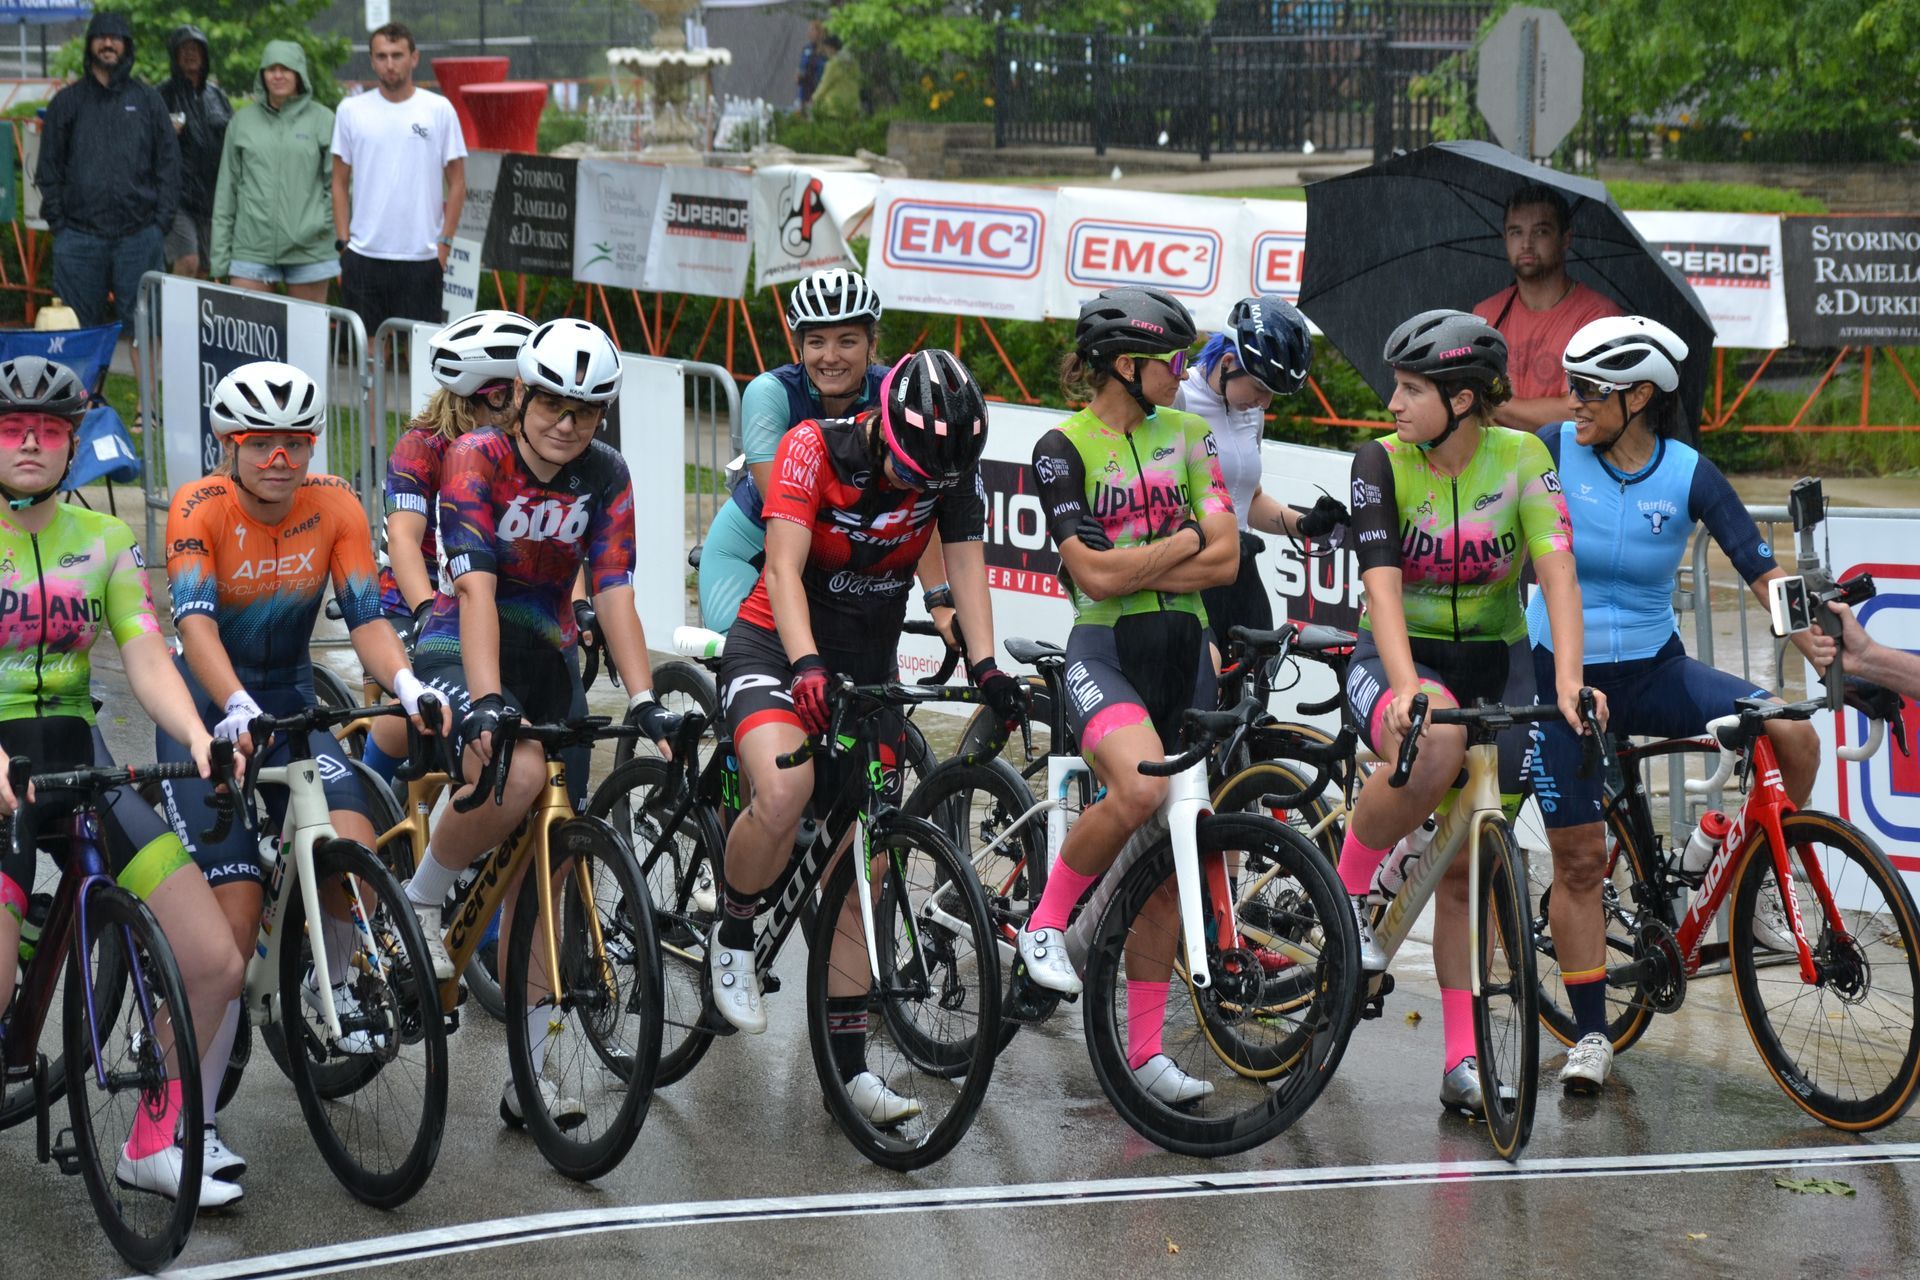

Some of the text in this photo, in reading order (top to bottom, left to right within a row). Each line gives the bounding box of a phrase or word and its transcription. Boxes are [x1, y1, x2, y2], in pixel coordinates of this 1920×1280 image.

[512, 162, 566, 193] STORINO,
[512, 192, 567, 220] RAMELLO
[664, 202, 752, 229] SUPERIOR
[509, 222, 568, 250] &DURKIN
[1661, 251, 1779, 276] PERIOR
[1813, 257, 1920, 283] RAMELL
[443, 282, 475, 299] RATION
[1816, 288, 1920, 315] &DURKI
[1131, 319, 1164, 335] GIRO
[1840, 327, 1898, 337] ATTORNEYS
[1439, 346, 1473, 360] GIRO
[788, 439, 821, 472] YOUR
[782, 458, 817, 489] OWN
[182, 485, 227, 518] JAKROO
[301, 477, 361, 500] JAKRO
[1093, 481, 1191, 519] UPLAND
[771, 512, 807, 526] PACTIMO
[1053, 501, 1082, 517] MUMU
[1637, 499, 1678, 515] fairlife
[284, 513, 321, 539] CARBS
[830, 525, 923, 548] PSIMET
[1359, 529, 1388, 543] MUMU
[1401, 518, 1517, 564] UPLAND
[231, 547, 316, 581] APEX
[450, 553, 471, 577] RIN
[218, 582, 281, 597] CYCLING
[989, 568, 1065, 595] ERVICE
[2, 588, 102, 622] PLAND
[8, 623, 87, 633] EWING
[1066, 660, 1104, 713] UPLAND
[1518, 694, 1541, 781] UPLA
[1530, 729, 1561, 813] fairlife
[161, 779, 197, 853] pedal
[203, 863, 262, 881] AKRO
[1691, 800, 1750, 923] RIDLEY
[753, 808, 834, 973] SCOTT
